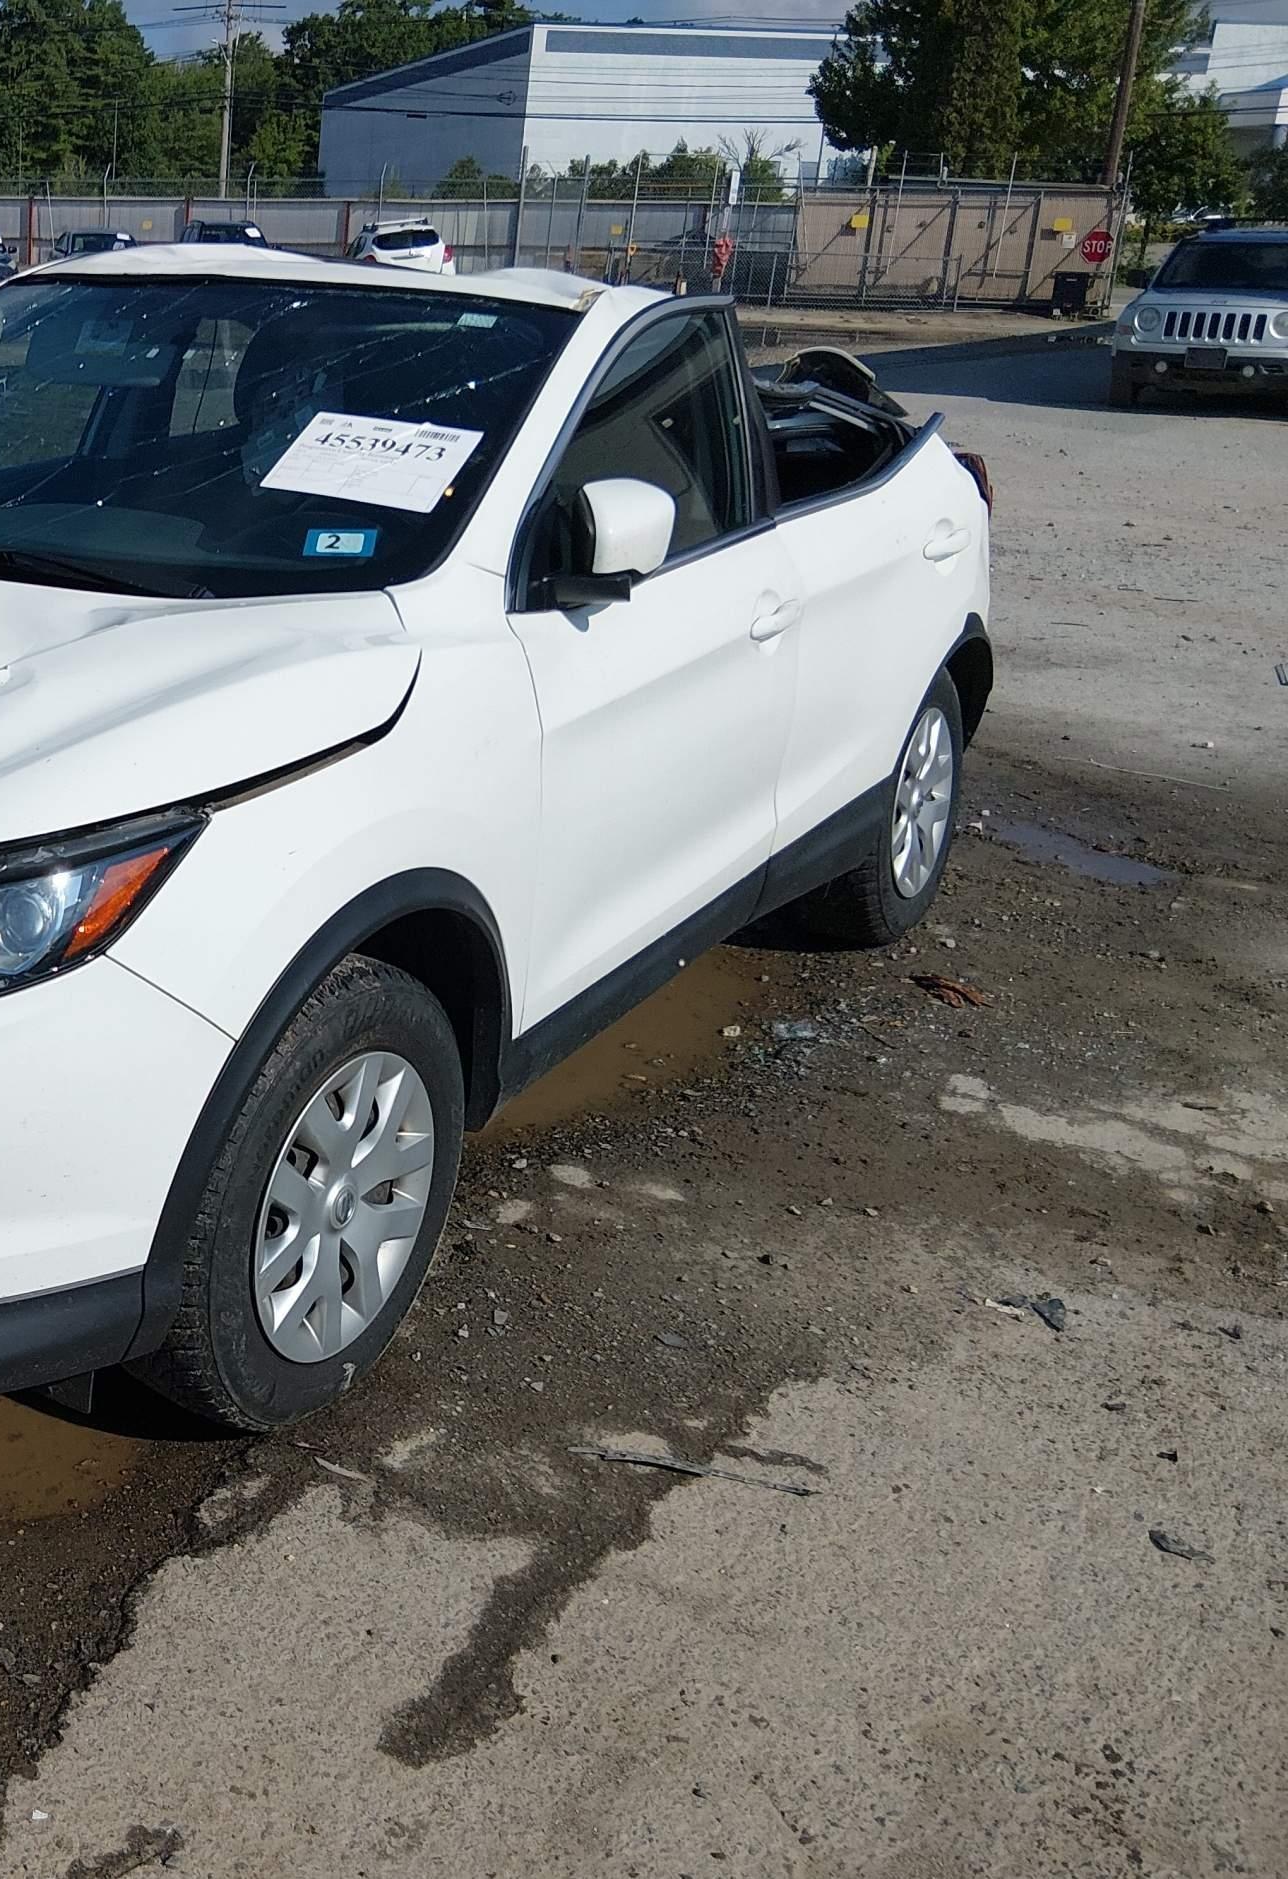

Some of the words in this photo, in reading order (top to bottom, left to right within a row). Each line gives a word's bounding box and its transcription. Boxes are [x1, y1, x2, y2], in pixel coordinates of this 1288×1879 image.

[1083, 240, 1112, 253] STOP
[315, 431, 446, 462] 45539473
[324, 534, 341, 550] 2
